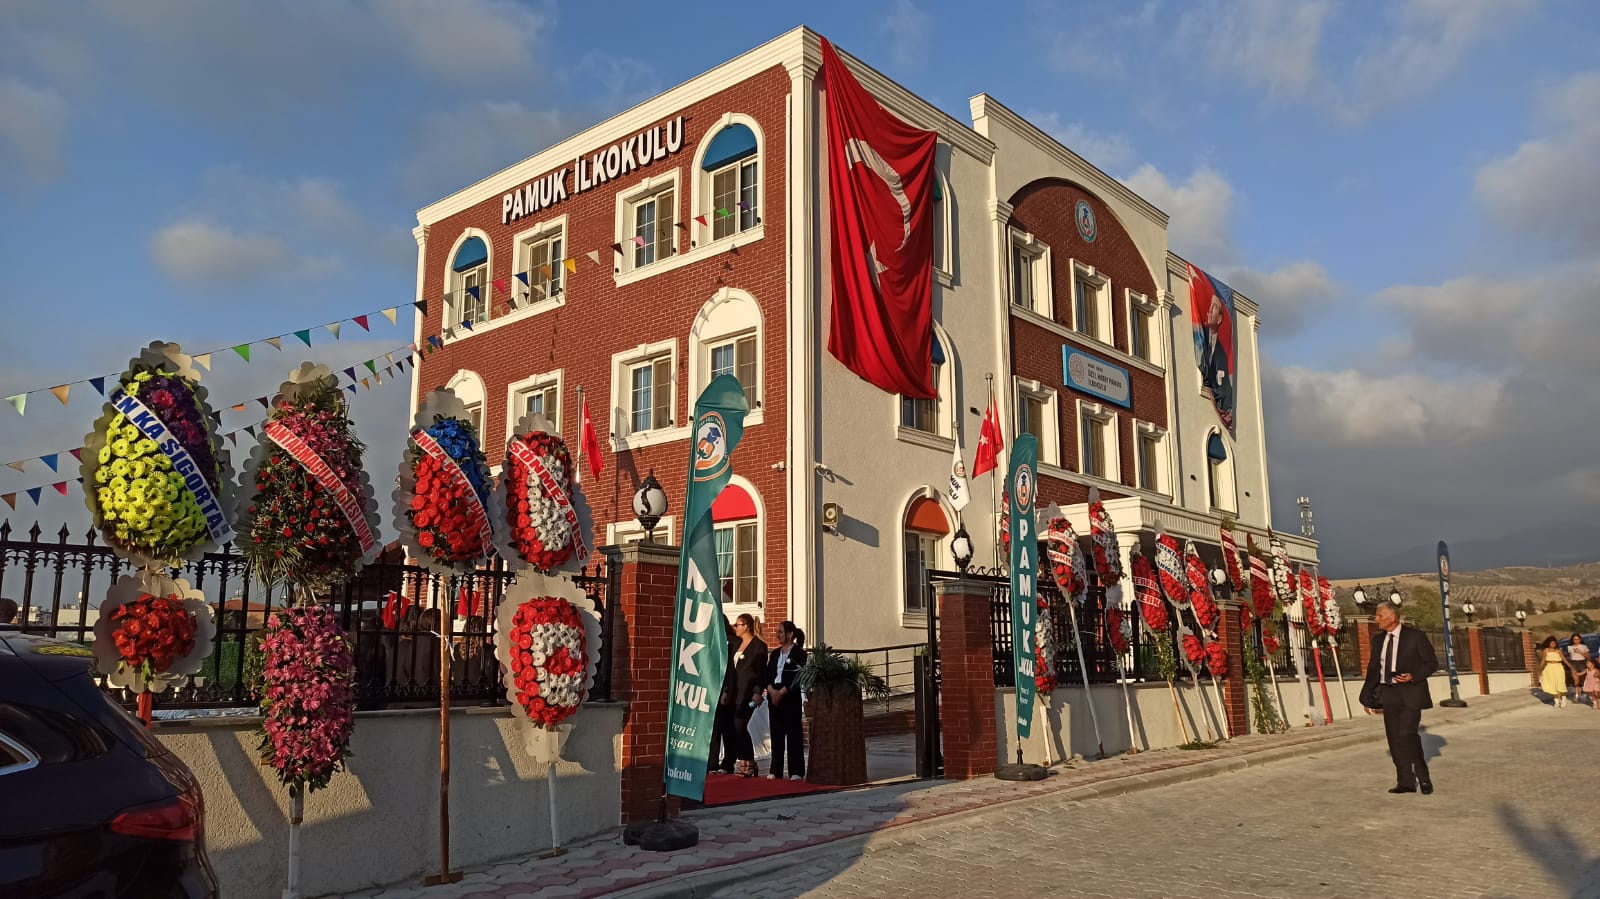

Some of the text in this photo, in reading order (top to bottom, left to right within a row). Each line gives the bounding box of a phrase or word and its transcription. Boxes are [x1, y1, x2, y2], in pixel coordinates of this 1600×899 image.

[502, 116, 682, 224] PAMUK İLKOKULU
[508, 441, 568, 506] SÖNMEZ
